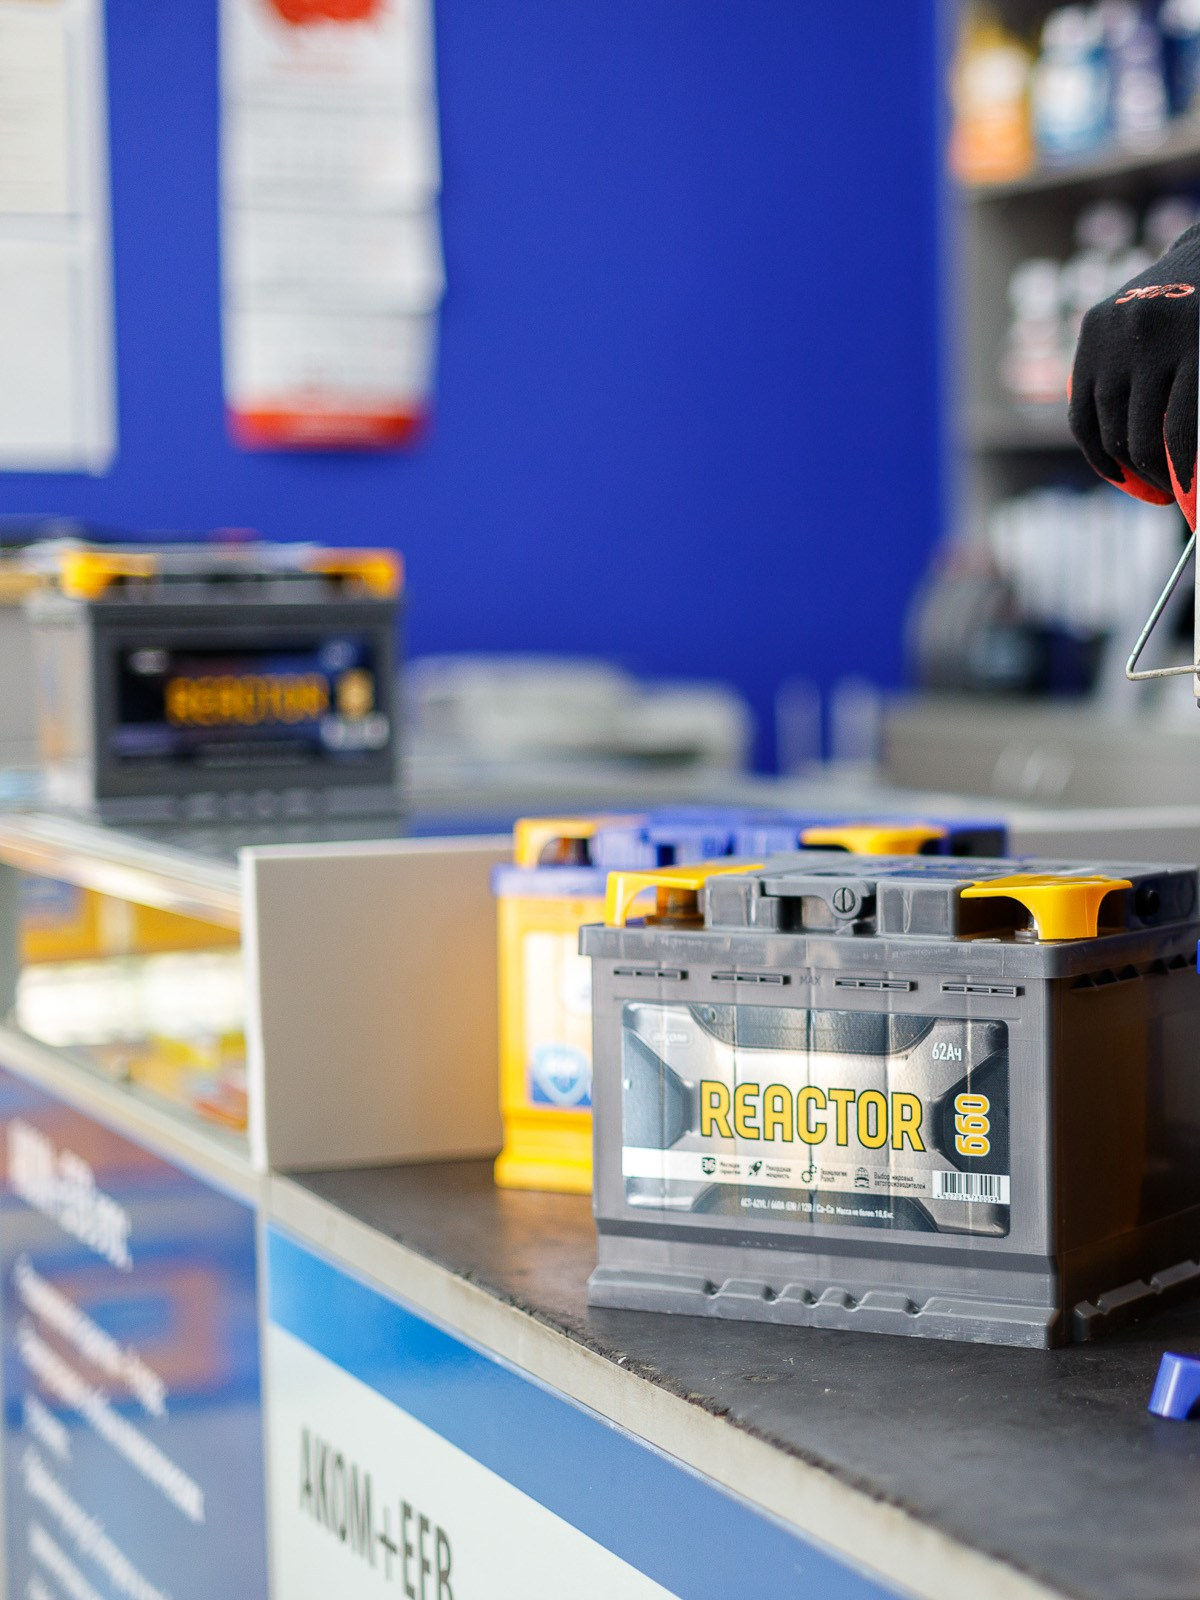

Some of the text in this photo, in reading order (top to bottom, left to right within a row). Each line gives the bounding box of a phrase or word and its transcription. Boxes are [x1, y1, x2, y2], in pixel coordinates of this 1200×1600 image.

[932, 1043, 962, 1062] 62Ач
[699, 1078, 928, 1153] REACTOR
[955, 1092, 991, 1157] 660
